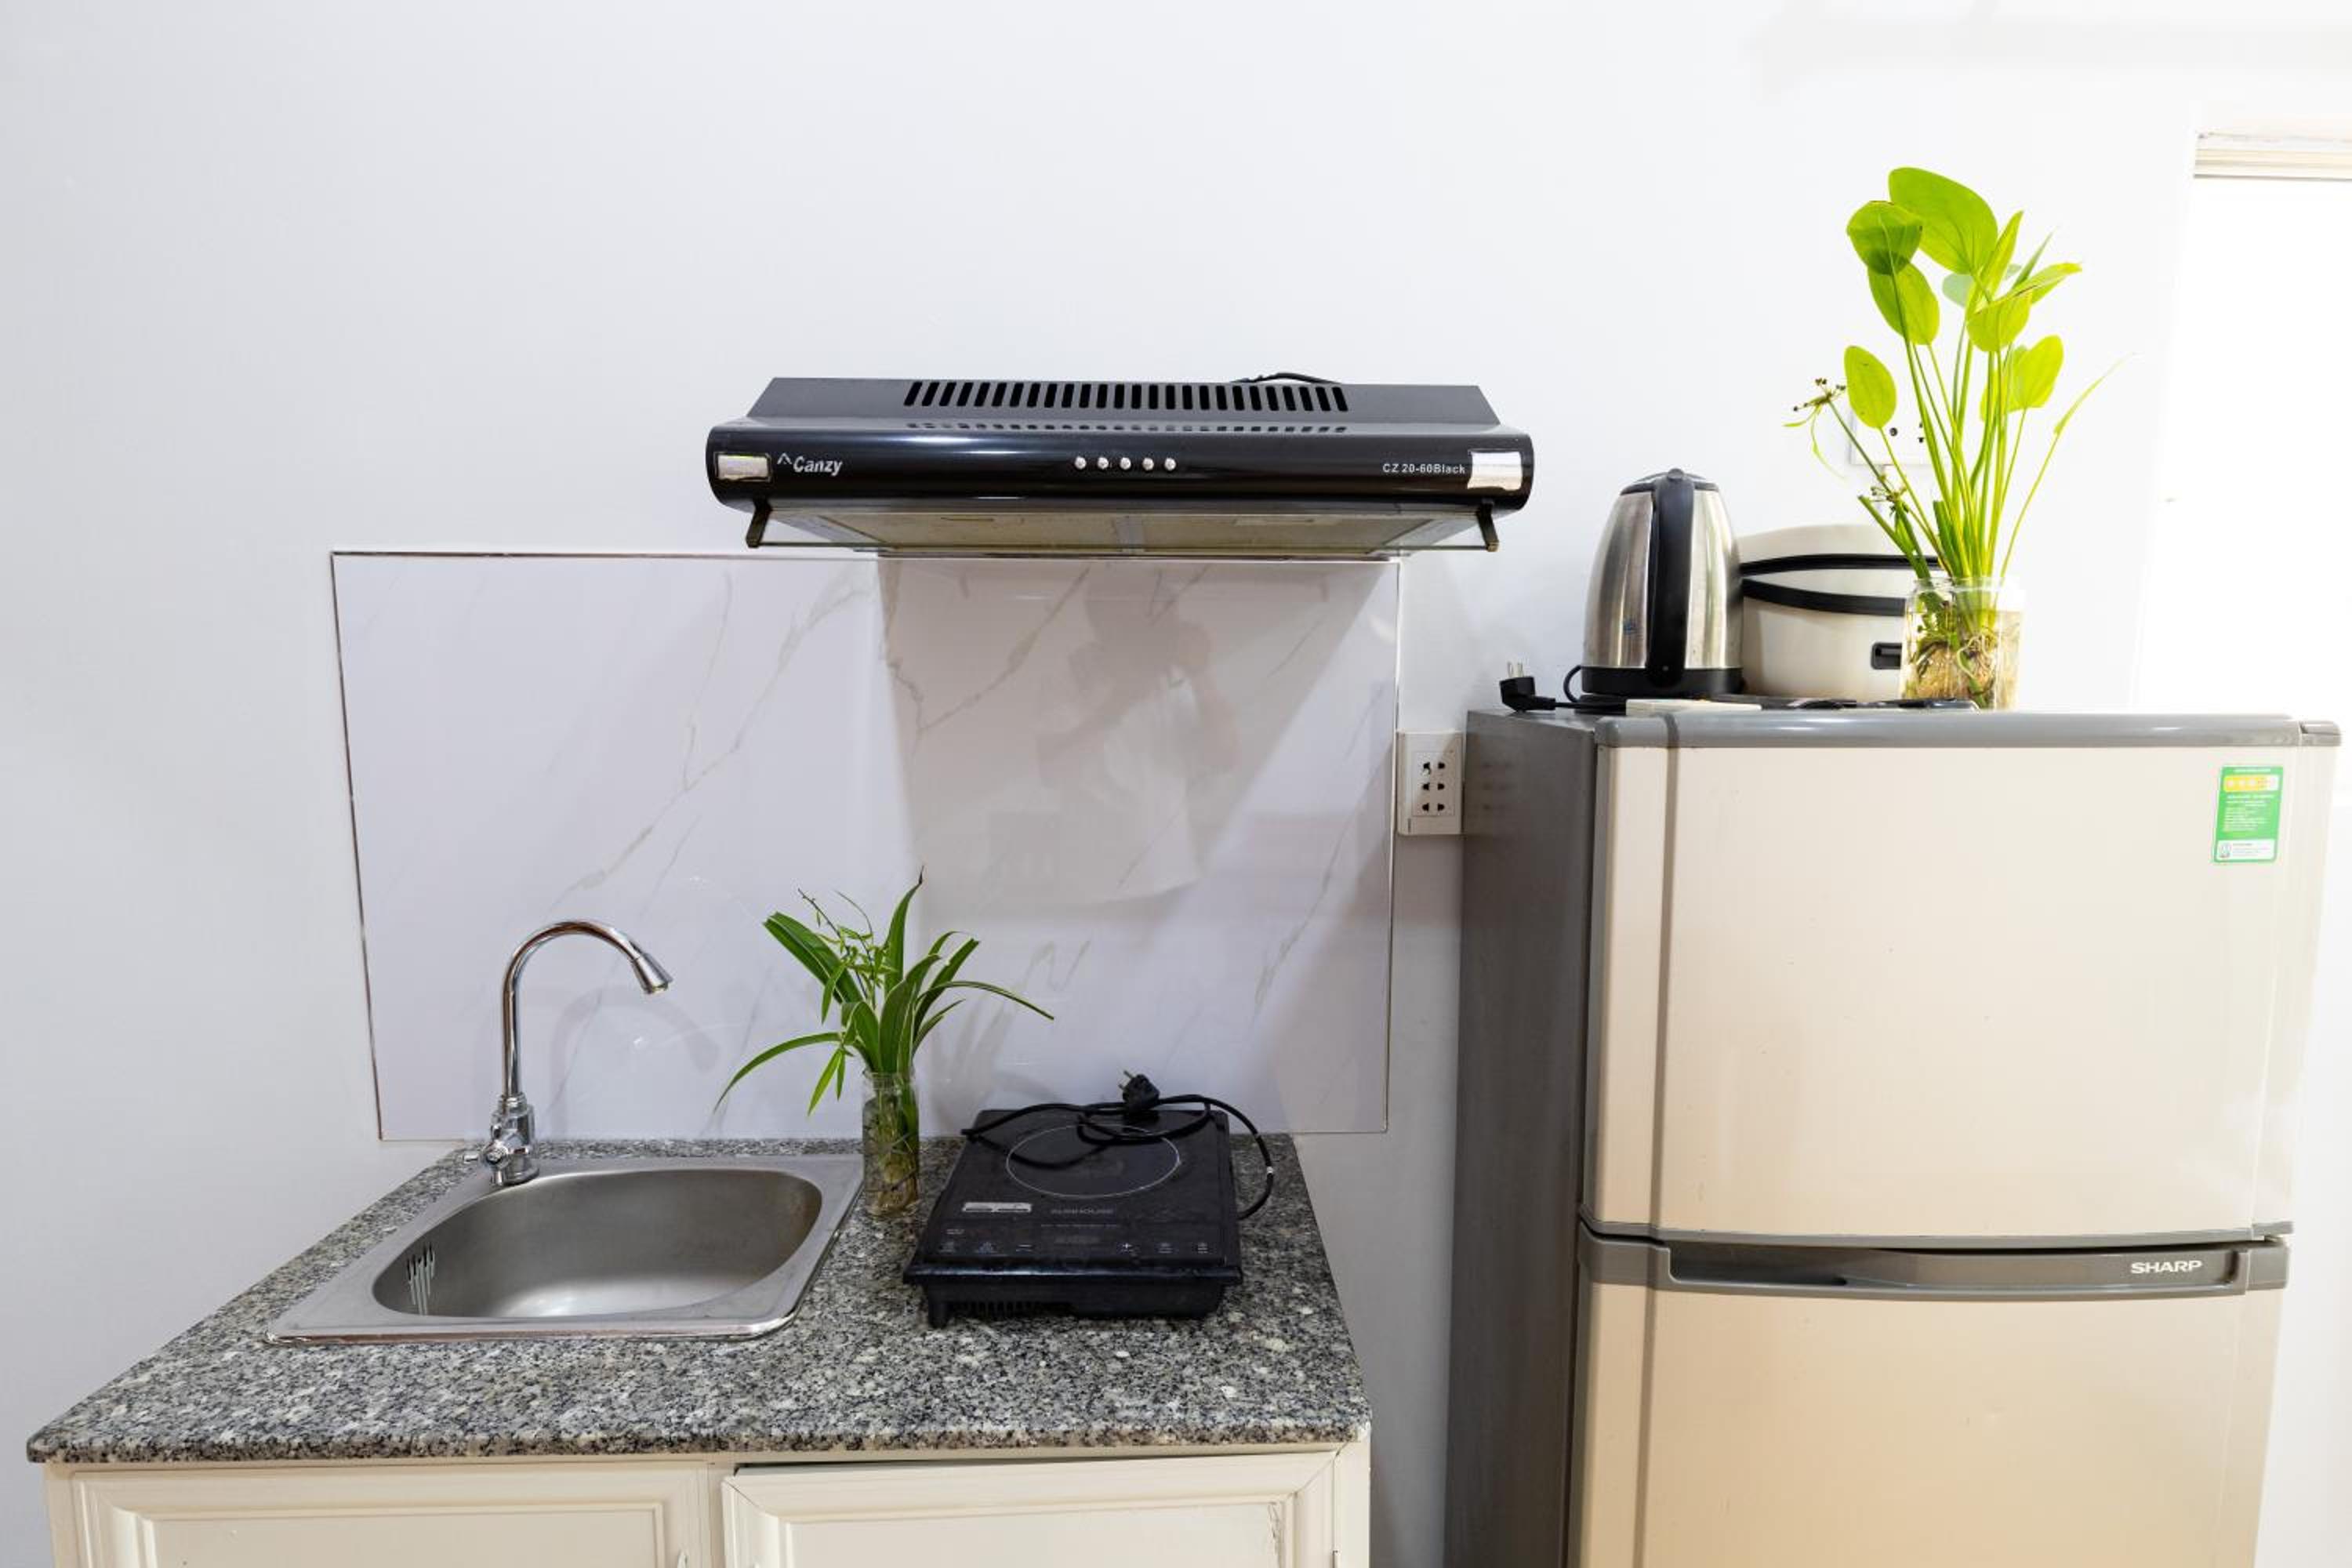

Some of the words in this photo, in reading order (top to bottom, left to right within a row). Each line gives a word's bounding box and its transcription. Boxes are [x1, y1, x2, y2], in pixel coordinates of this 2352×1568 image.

[793, 456, 843, 477] Canzy
[1382, 463, 1399, 473] CZ
[2131, 1260, 2202, 1274] SHARP
